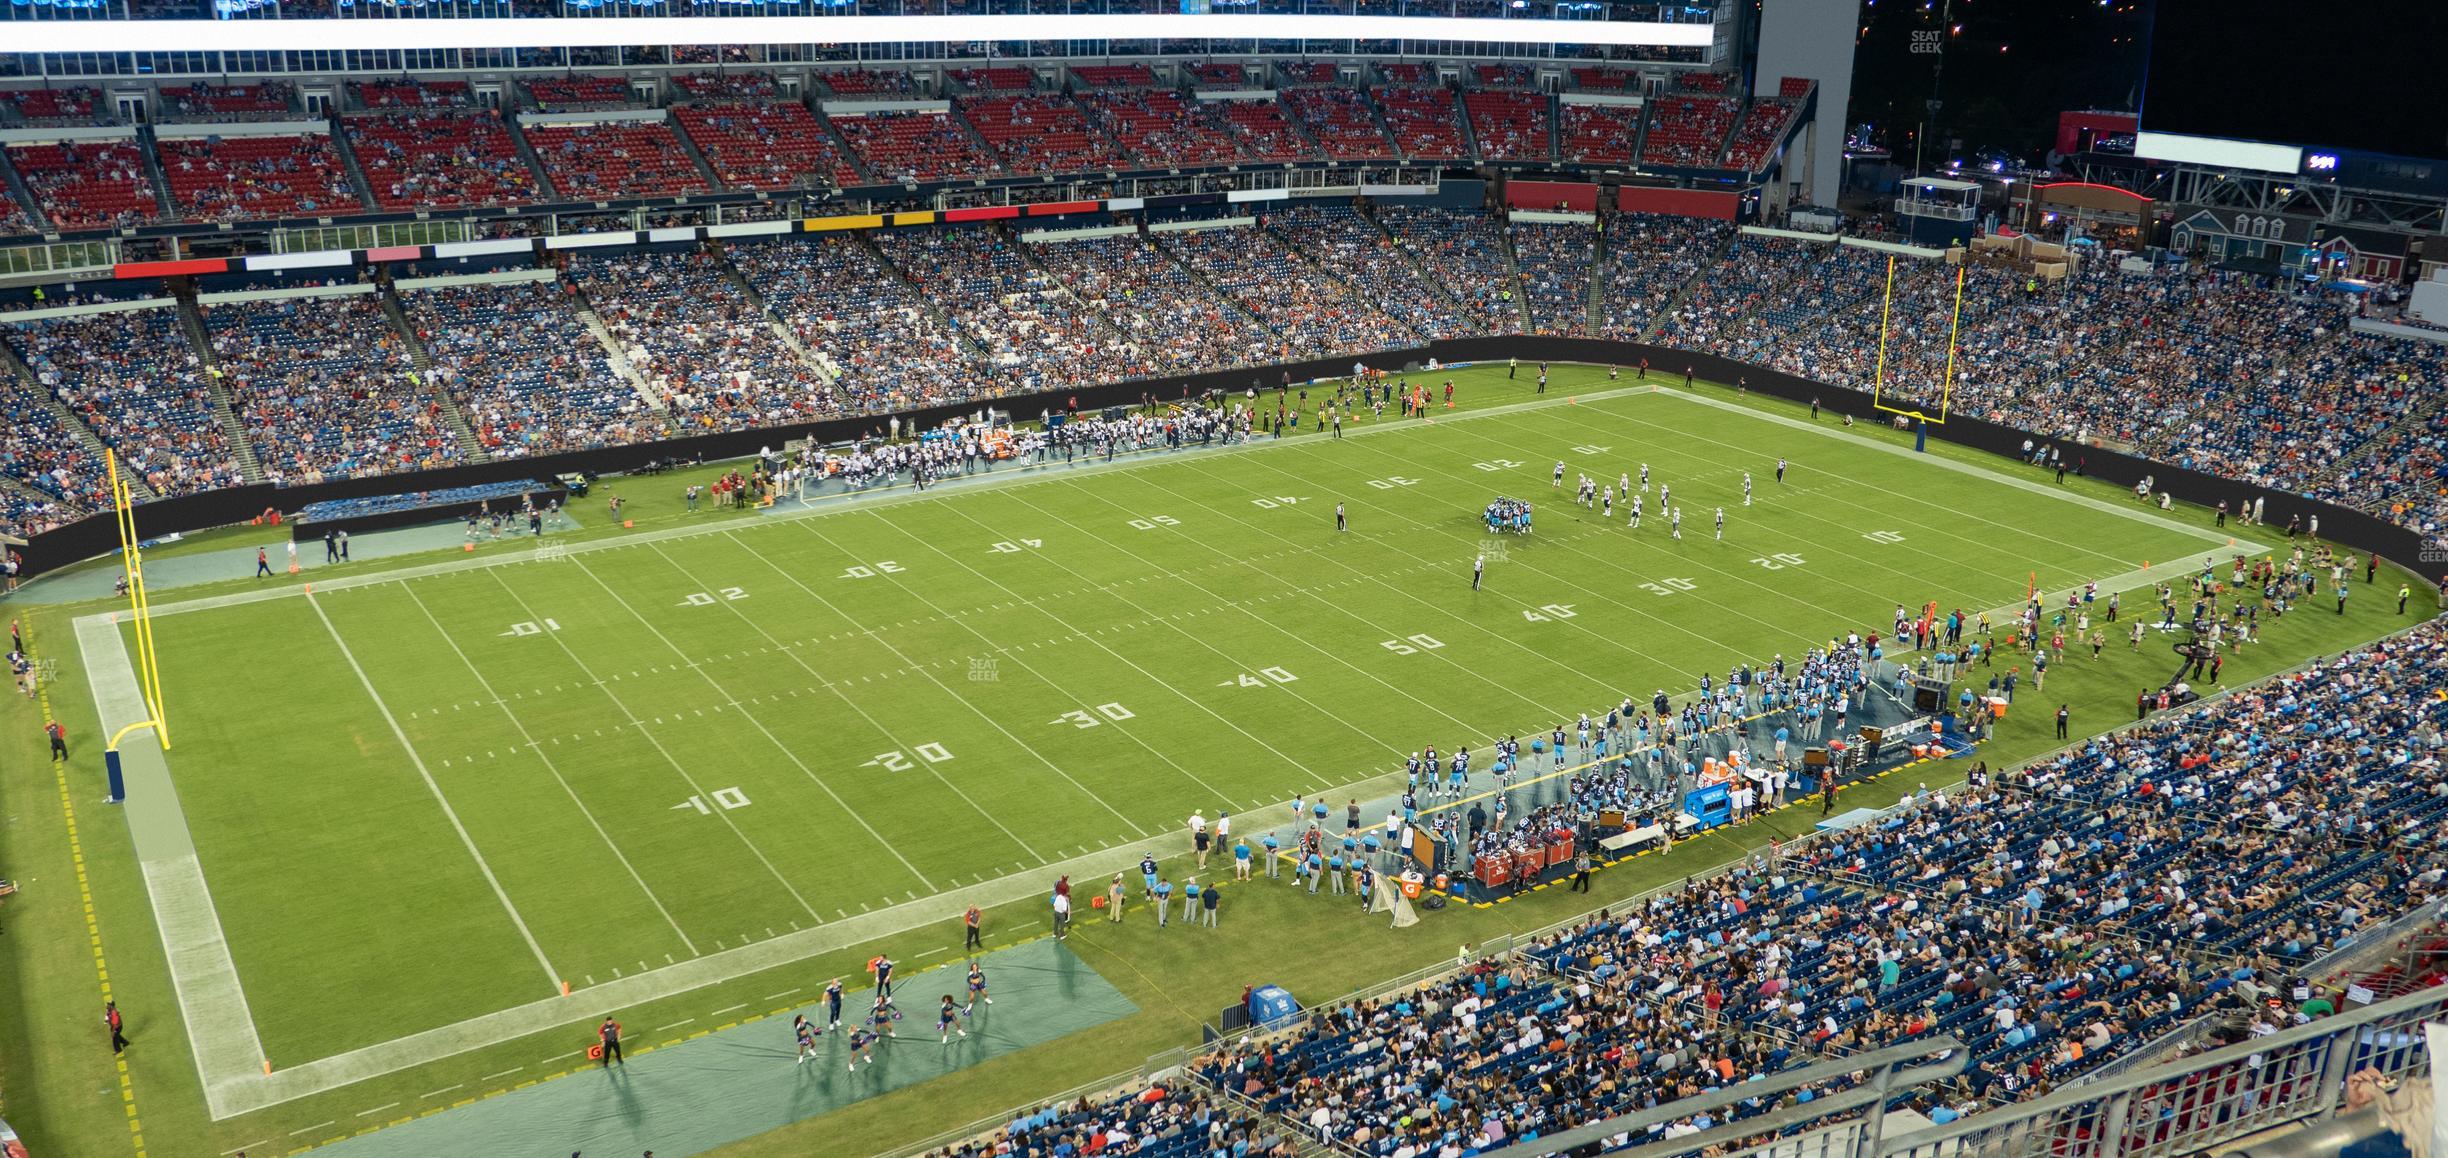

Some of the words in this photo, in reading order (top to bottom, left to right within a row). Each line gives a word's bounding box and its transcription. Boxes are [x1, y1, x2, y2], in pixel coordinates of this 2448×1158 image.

[1127, 516, 1180, 529] 50
[1864, 530, 1905, 544] 10
[1750, 552, 1805, 569] 20
[1638, 577, 1697, 595] 30
[1523, 603, 1578, 621] 40
[1380, 633, 1446, 654] 50
[1237, 666, 1299, 687] 40
[1061, 702, 1136, 728] 30
[876, 741, 954, 772] 20
[690, 786, 752, 814] 10
[1434, 821, 1444, 829] 92
[1405, 884, 1414, 894] G
[592, 1047, 601, 1057] G
